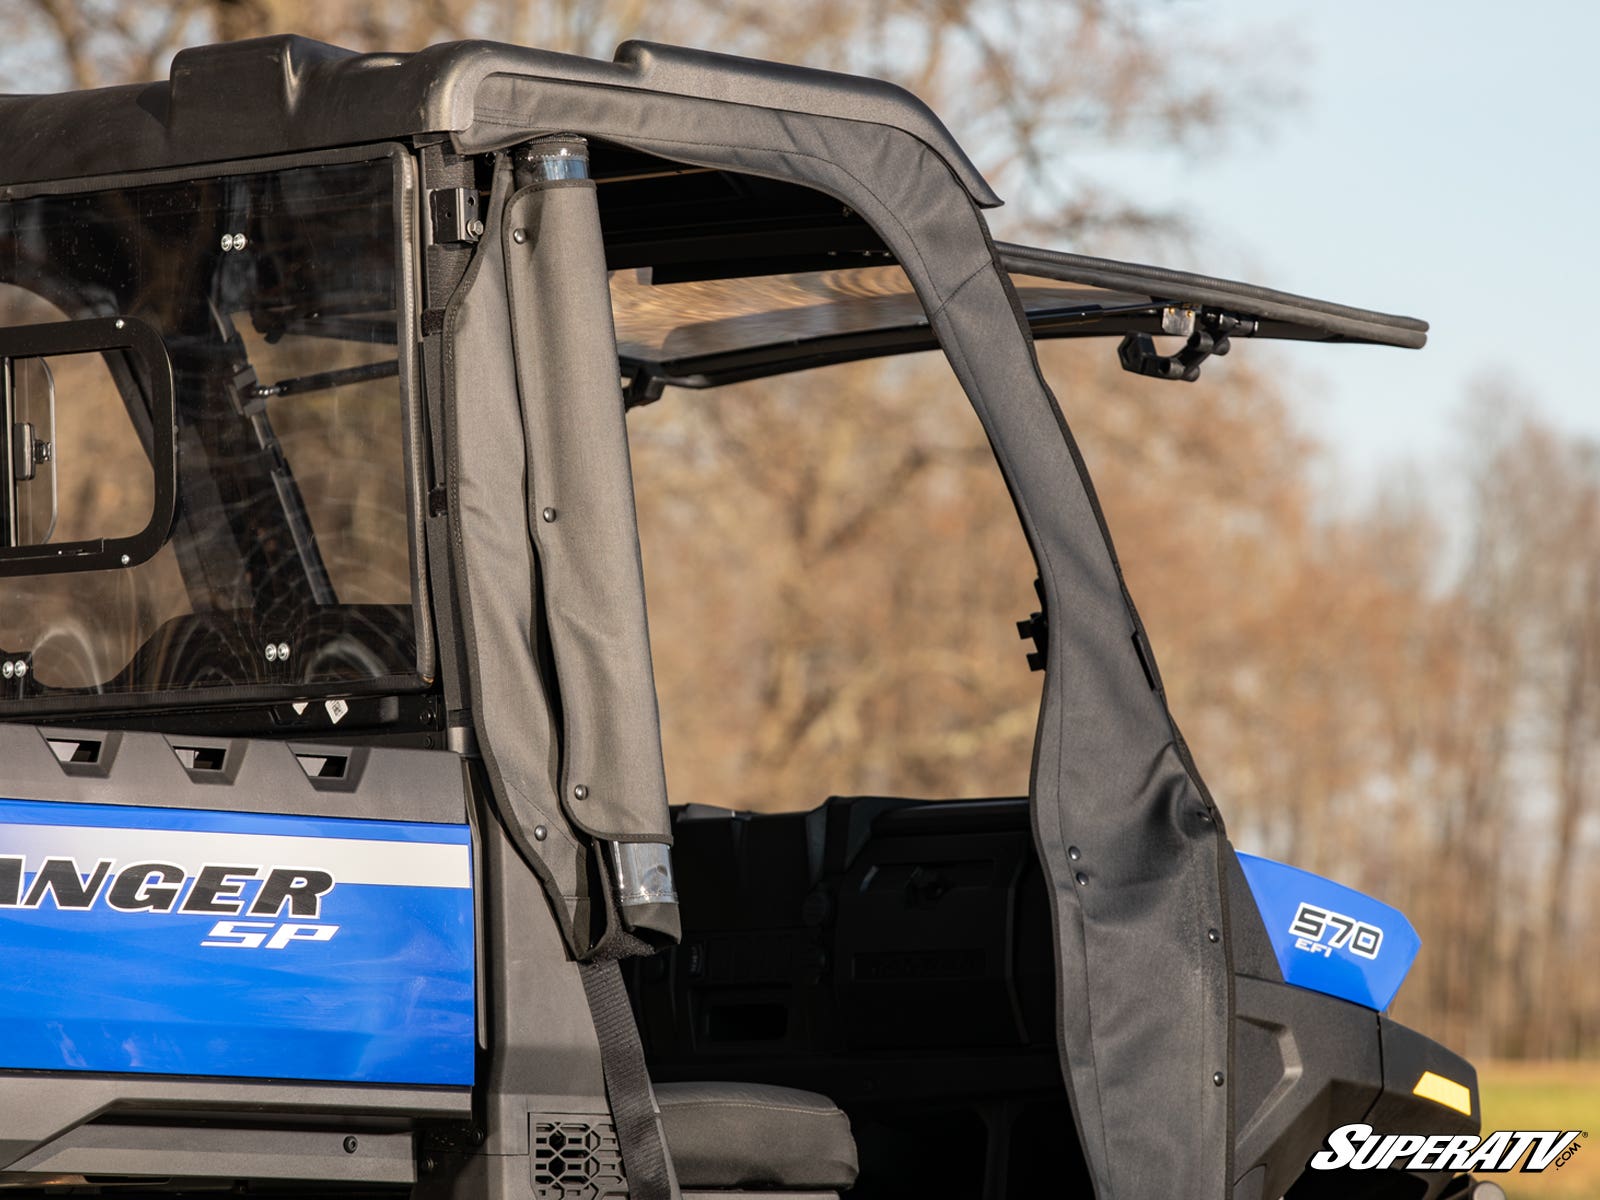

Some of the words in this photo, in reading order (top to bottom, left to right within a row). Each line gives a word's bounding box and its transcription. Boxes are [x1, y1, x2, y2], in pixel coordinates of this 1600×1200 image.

[200, 921, 340, 949] SP
[1288, 902, 1384, 960] 570
[1295, 938, 1332, 958] EFI
